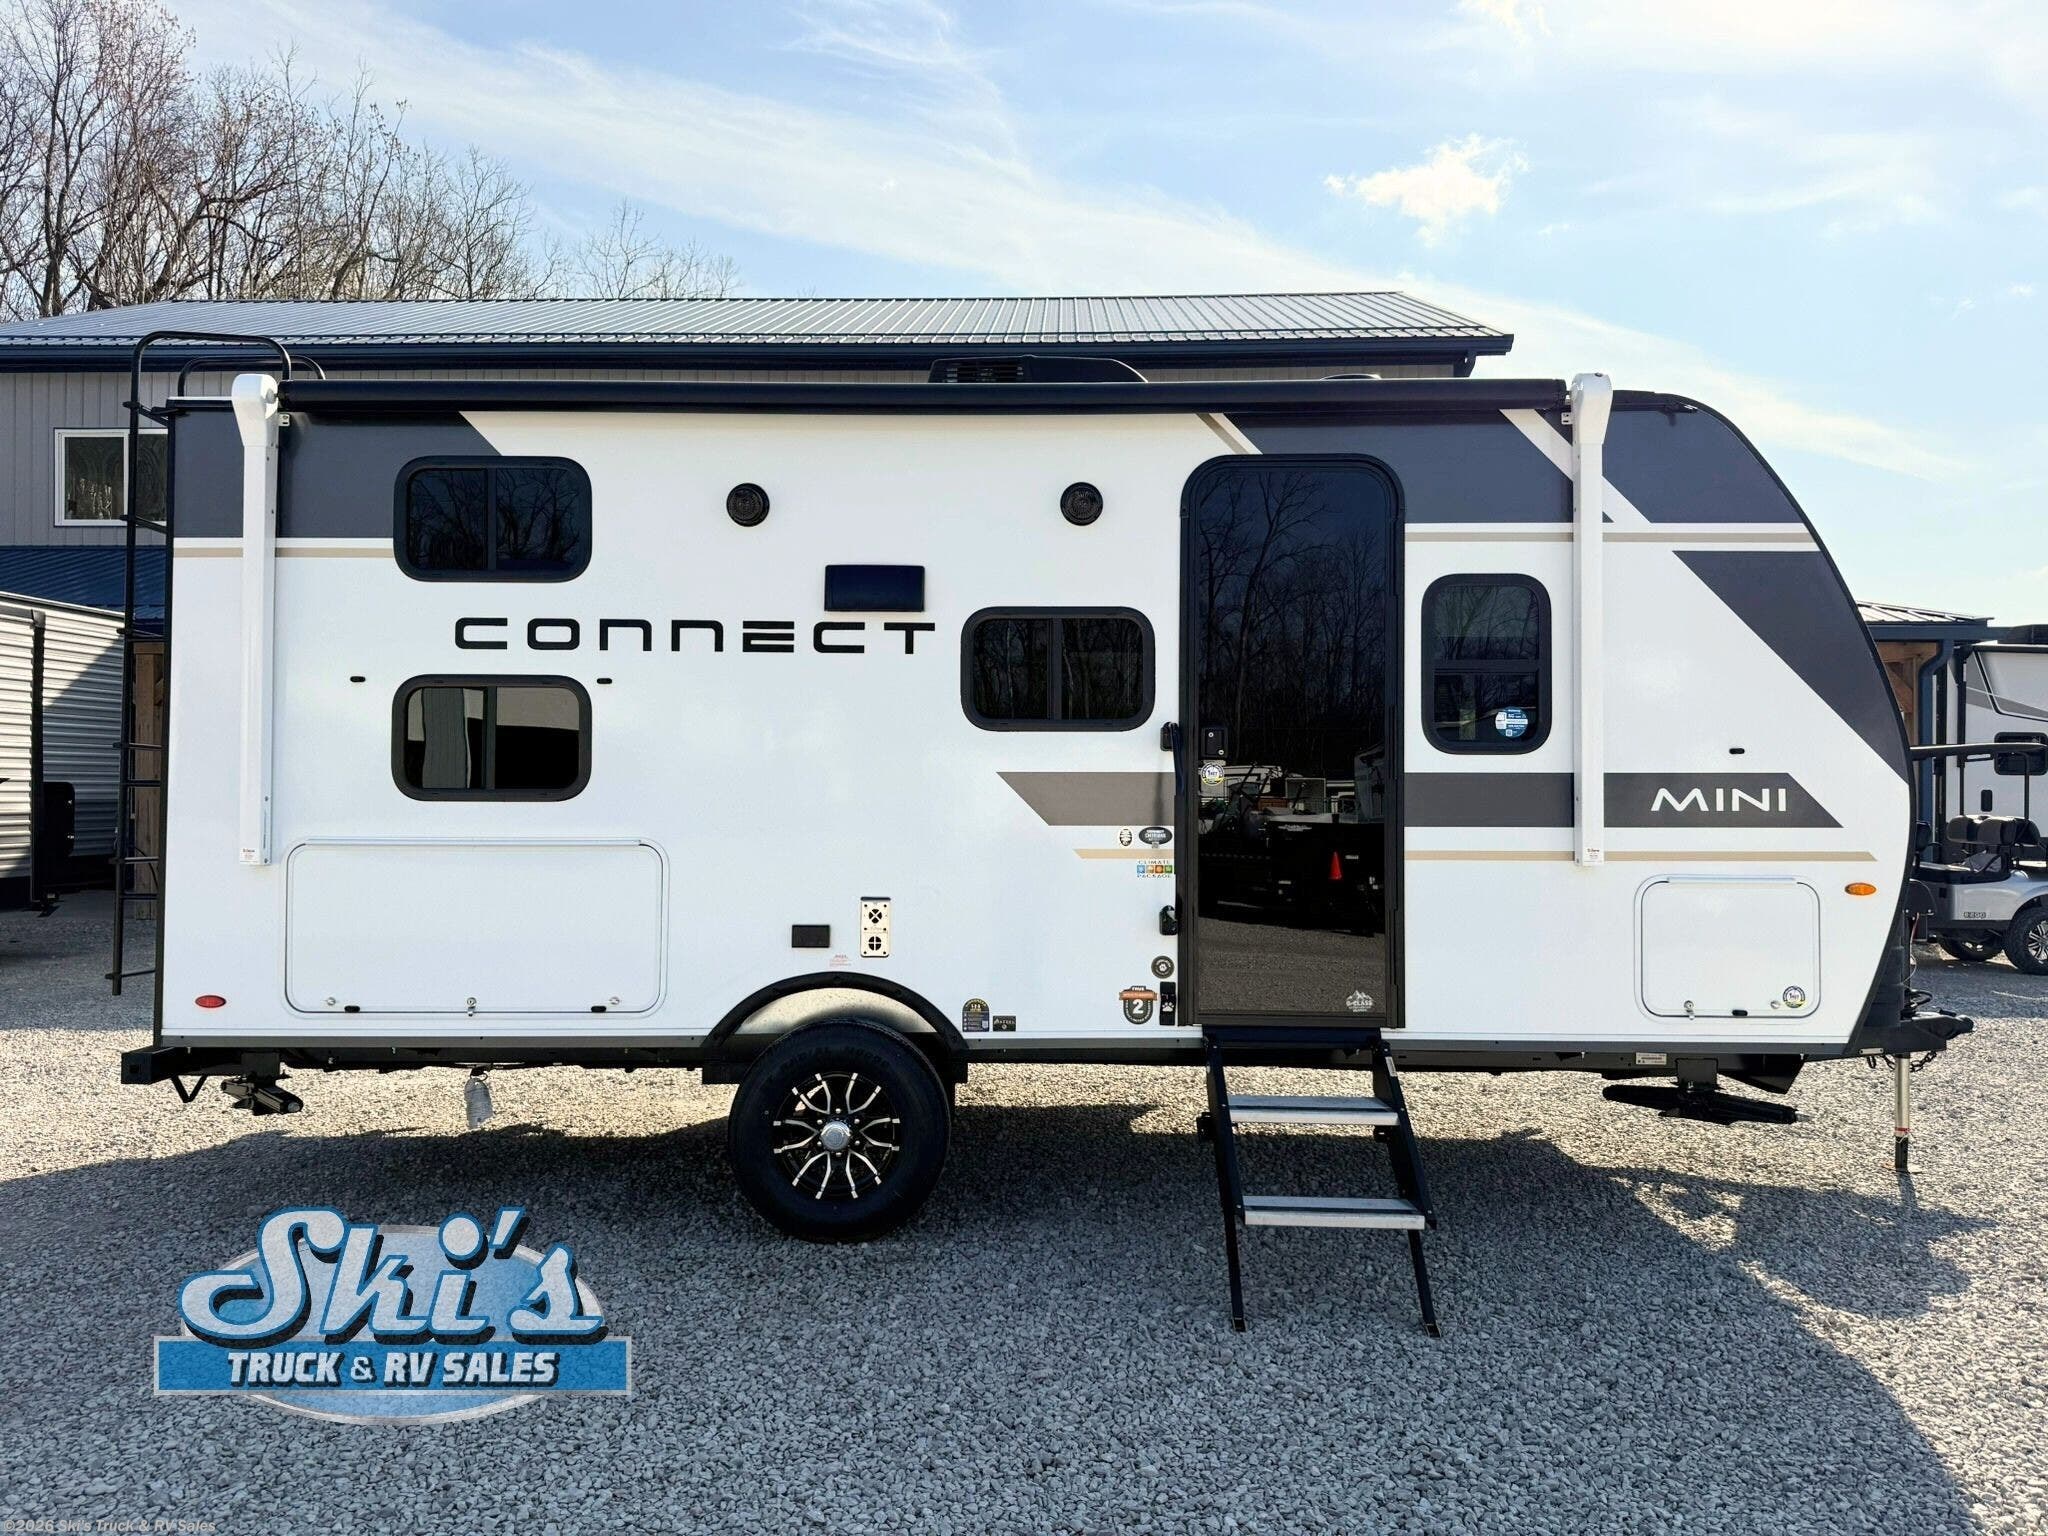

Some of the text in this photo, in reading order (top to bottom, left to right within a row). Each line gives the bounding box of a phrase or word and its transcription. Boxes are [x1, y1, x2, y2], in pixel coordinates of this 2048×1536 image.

[454, 617, 936, 655] CONNECT
[1650, 787, 1787, 812] MINI
[1132, 998, 1144, 1014] 2
